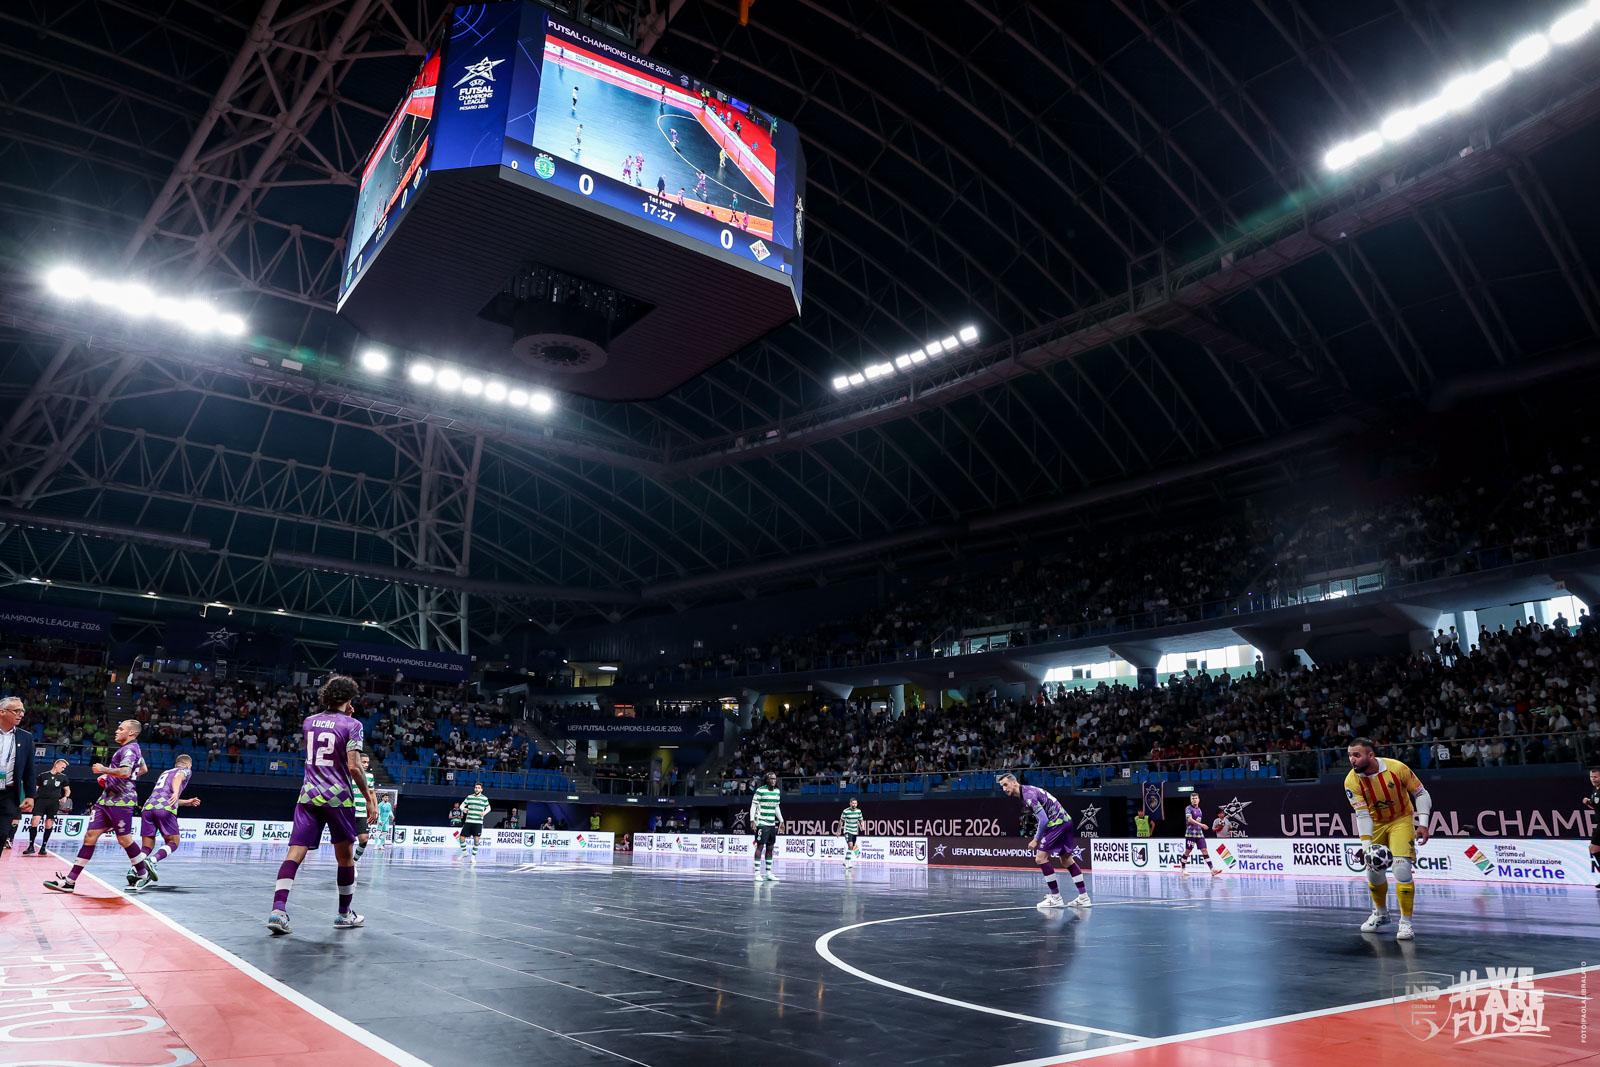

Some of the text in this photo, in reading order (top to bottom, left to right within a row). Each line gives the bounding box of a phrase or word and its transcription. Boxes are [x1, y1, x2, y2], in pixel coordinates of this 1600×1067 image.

[547, 20, 671, 77] FUTSAL CHAMPIONS LEAGUE 2026
[459, 86, 494, 96] FUTSAL
[459, 93, 493, 101] CHAMPIONS
[511, 160, 518, 169] 0
[578, 174, 594, 195] 0
[659, 199, 673, 209] Half
[642, 202, 676, 223] 17:27
[720, 229, 734, 249] 0
[780, 264, 785, 272] 1
[45, 618, 80, 629] LEAGUE
[81, 622, 101, 631] 2026
[360, 653, 386, 663] FUTSAL
[387, 656, 424, 667] CHAMPIONS
[424, 661, 449, 670] LEAGUE
[667, 725, 682, 733] 2026
[306, 731, 336, 767] 12
[786, 820, 829, 835] FUTSAL
[908, 819, 961, 836] LEAGUE
[965, 819, 1000, 836] 2026
[1281, 813, 1348, 837] UEFA
[786, 838, 805, 846] REGIONE
[889, 841, 914, 849] REGIONE
[1093, 842, 1129, 852] REGIONE
[889, 848, 914, 857] MARCHE
[952, 848, 967, 856] UEFA
[968, 848, 992, 857] FUTSAL
[993, 848, 1032, 857] CHAMPIONS
[1158, 843, 1185, 853] LET'S
[1293, 843, 1340, 854] REGIONE
[861, 852, 885, 860] Marche
[1093, 852, 1130, 862] MARCHE
[1293, 854, 1342, 866] MARCHE
[1497, 857, 1562, 865] Internazionalizzazione
[1239, 860, 1284, 871] Marche
[1498, 864, 1565, 879] Marche
